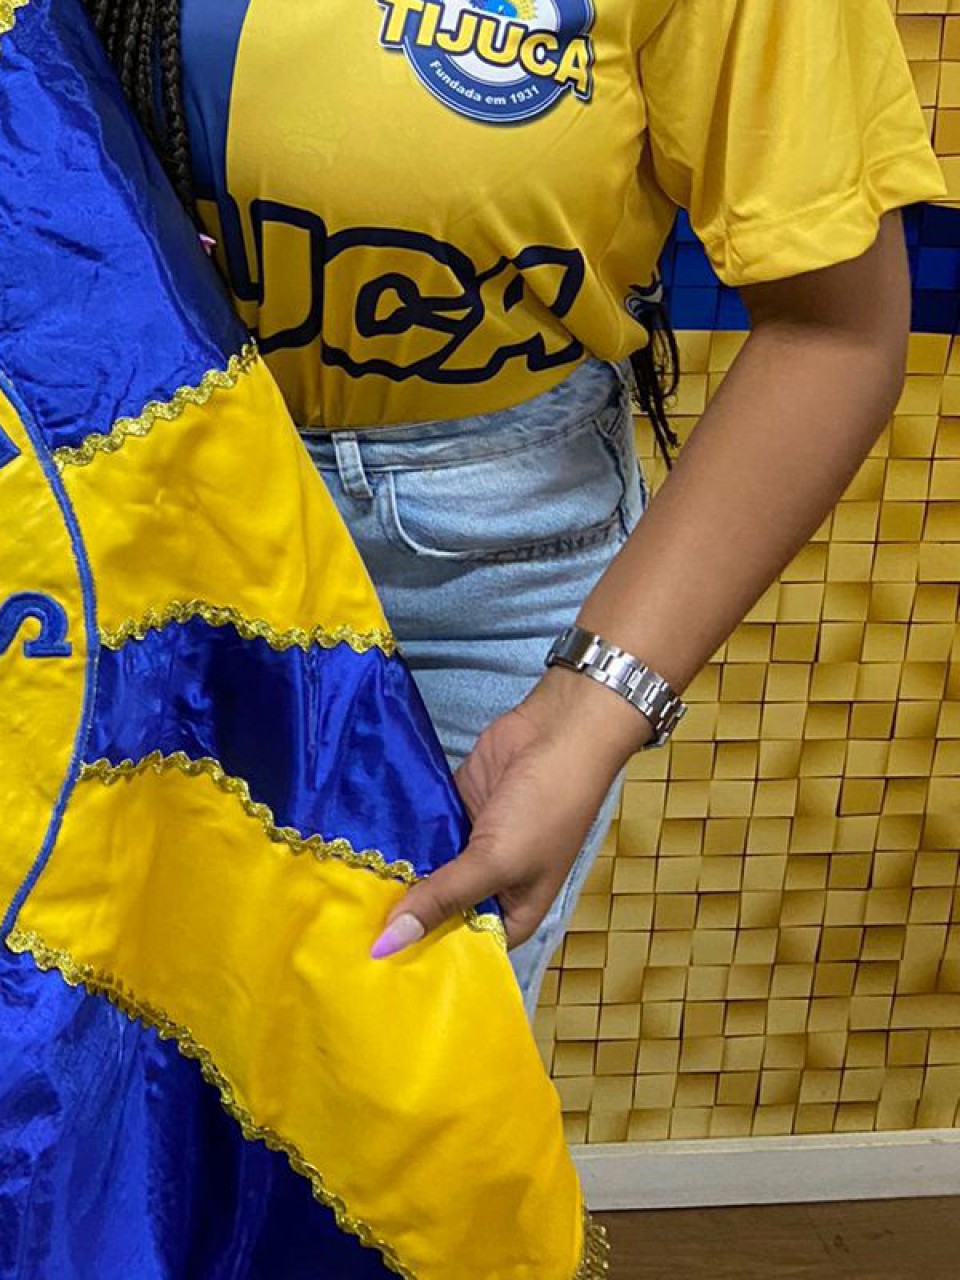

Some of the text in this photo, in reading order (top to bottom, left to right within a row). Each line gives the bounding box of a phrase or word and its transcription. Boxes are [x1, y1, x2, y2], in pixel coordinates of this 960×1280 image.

[429, 60, 540, 106] Fundada em 1931
